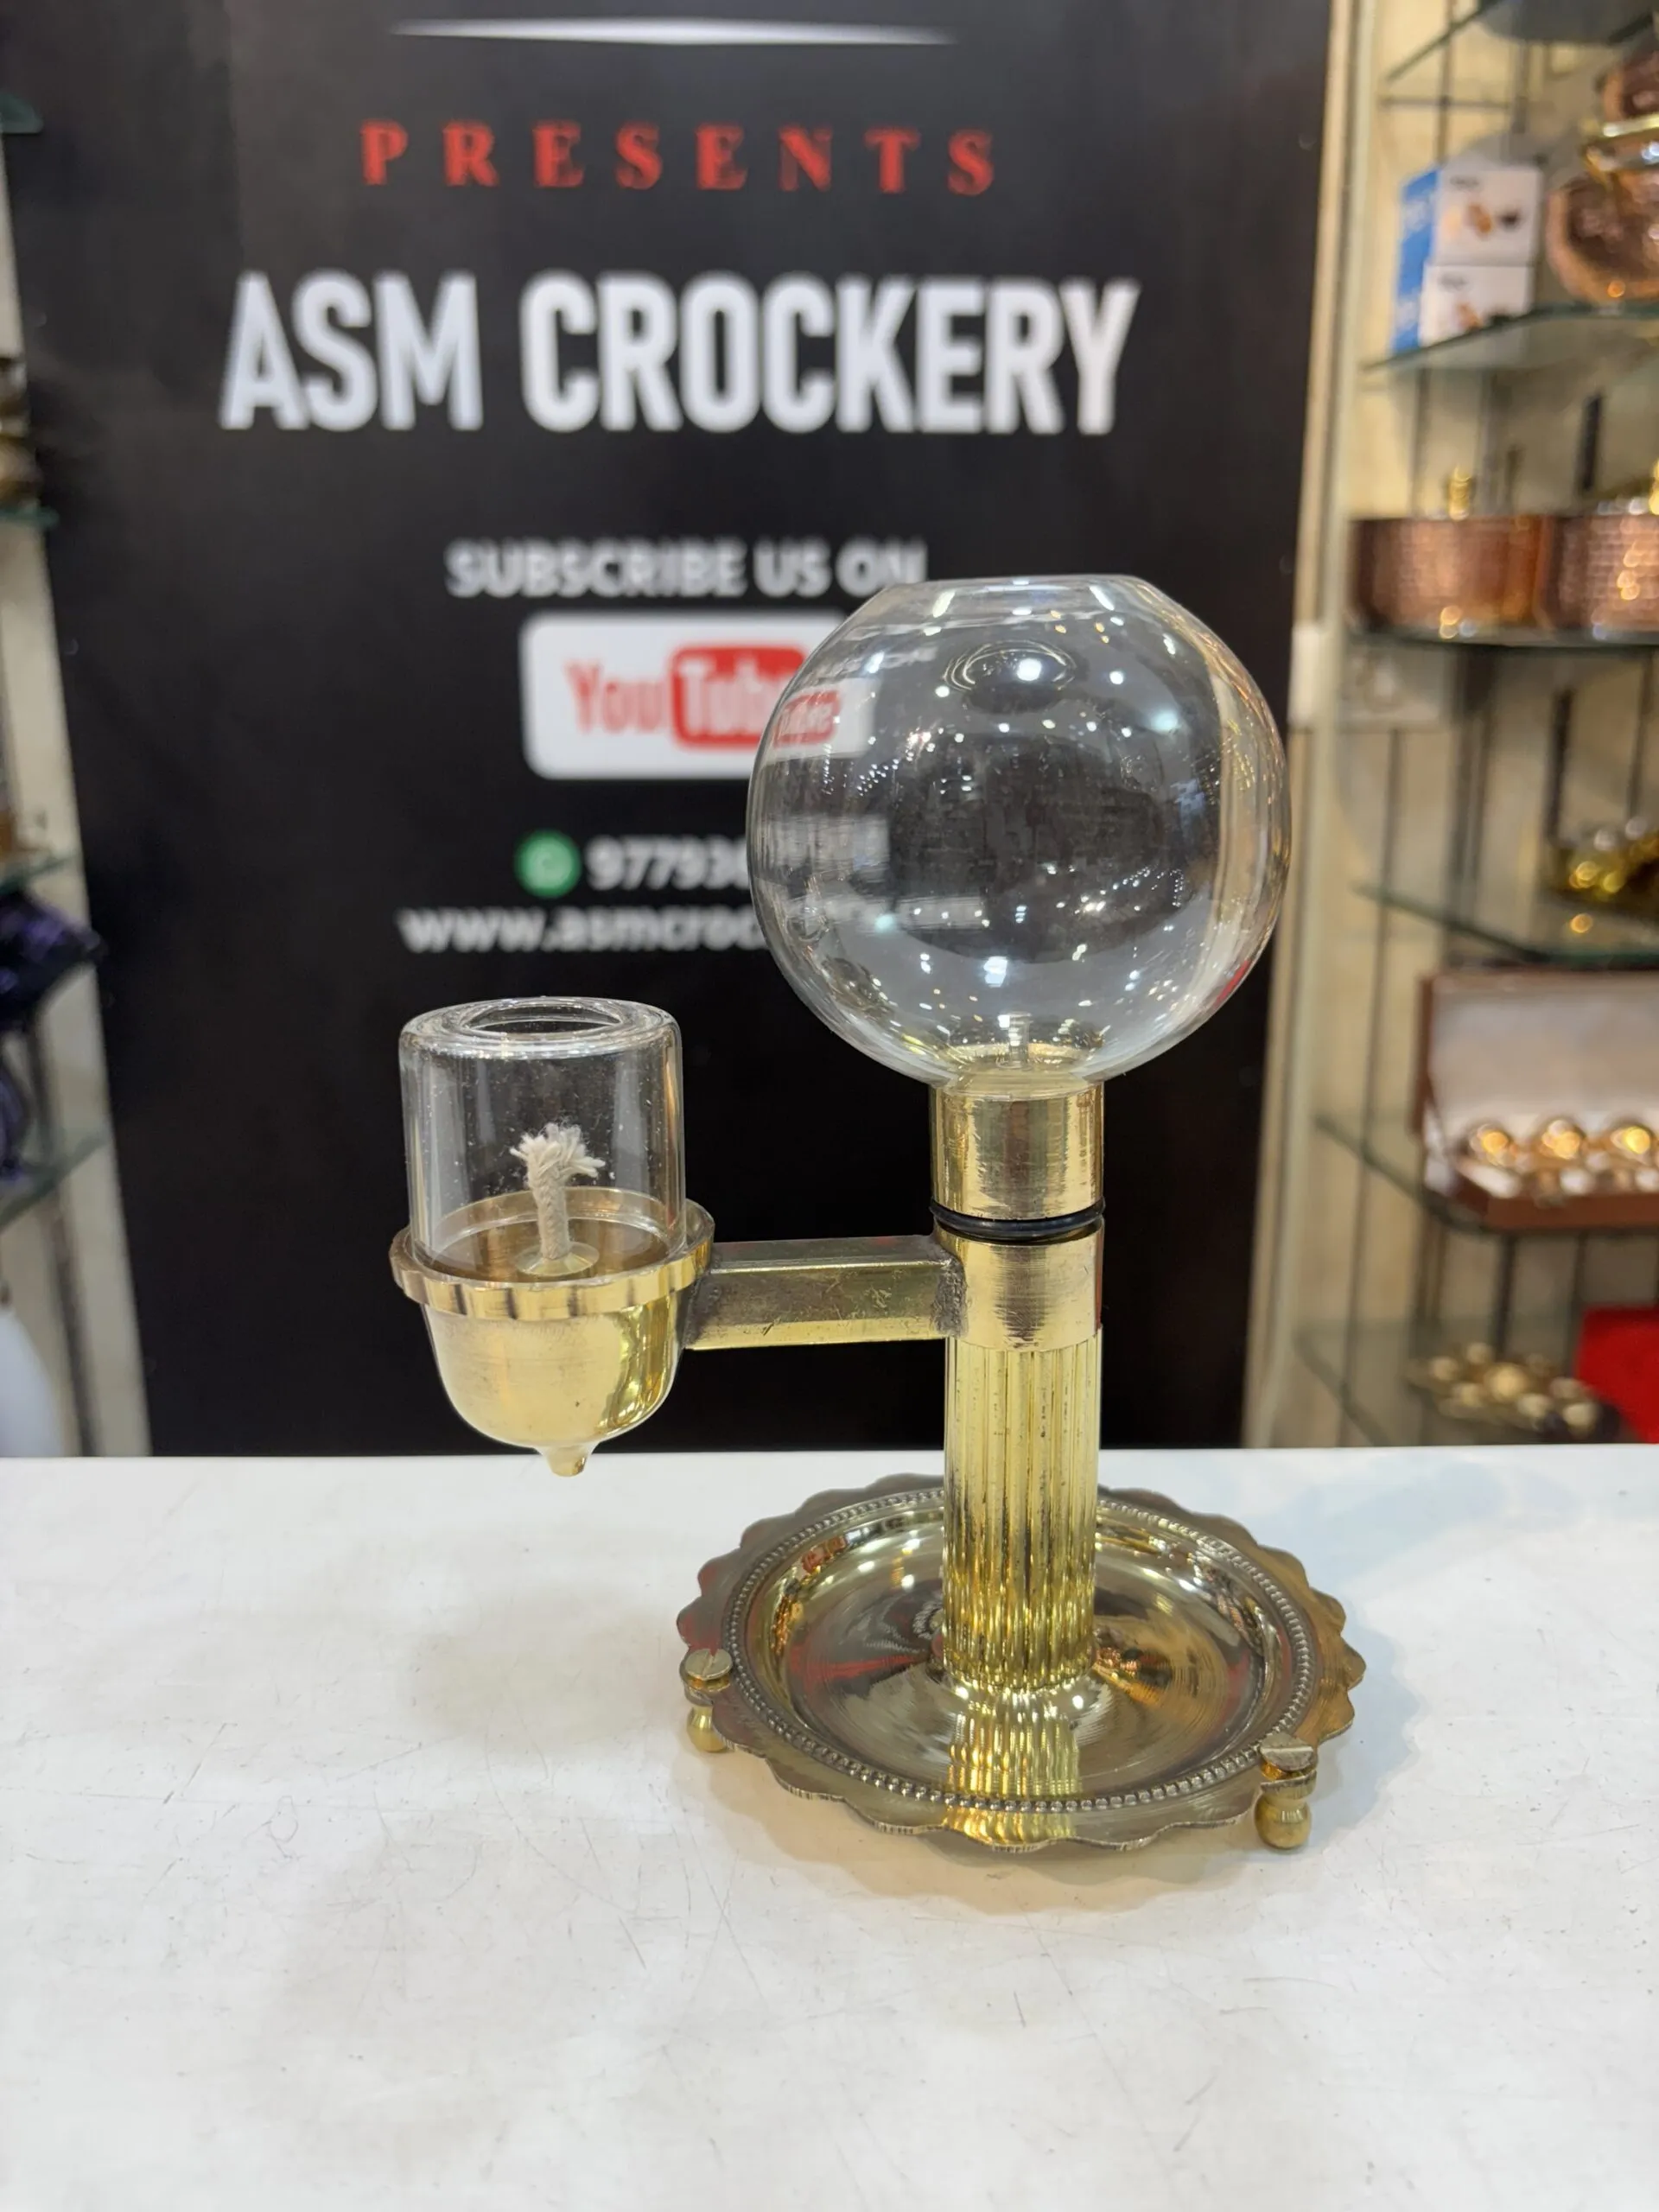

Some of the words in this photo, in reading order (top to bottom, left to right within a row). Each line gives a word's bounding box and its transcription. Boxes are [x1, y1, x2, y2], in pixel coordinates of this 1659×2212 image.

[359, 120, 995, 194] PRESENTS
[220, 270, 483, 431] ASM
[519, 271, 1140, 435] CROCKERY
[446, 539, 747, 598] SUBSCRIBE
[753, 540, 831, 596] US
[836, 539, 927, 596] ON
[563, 653, 783, 734] YouTub
